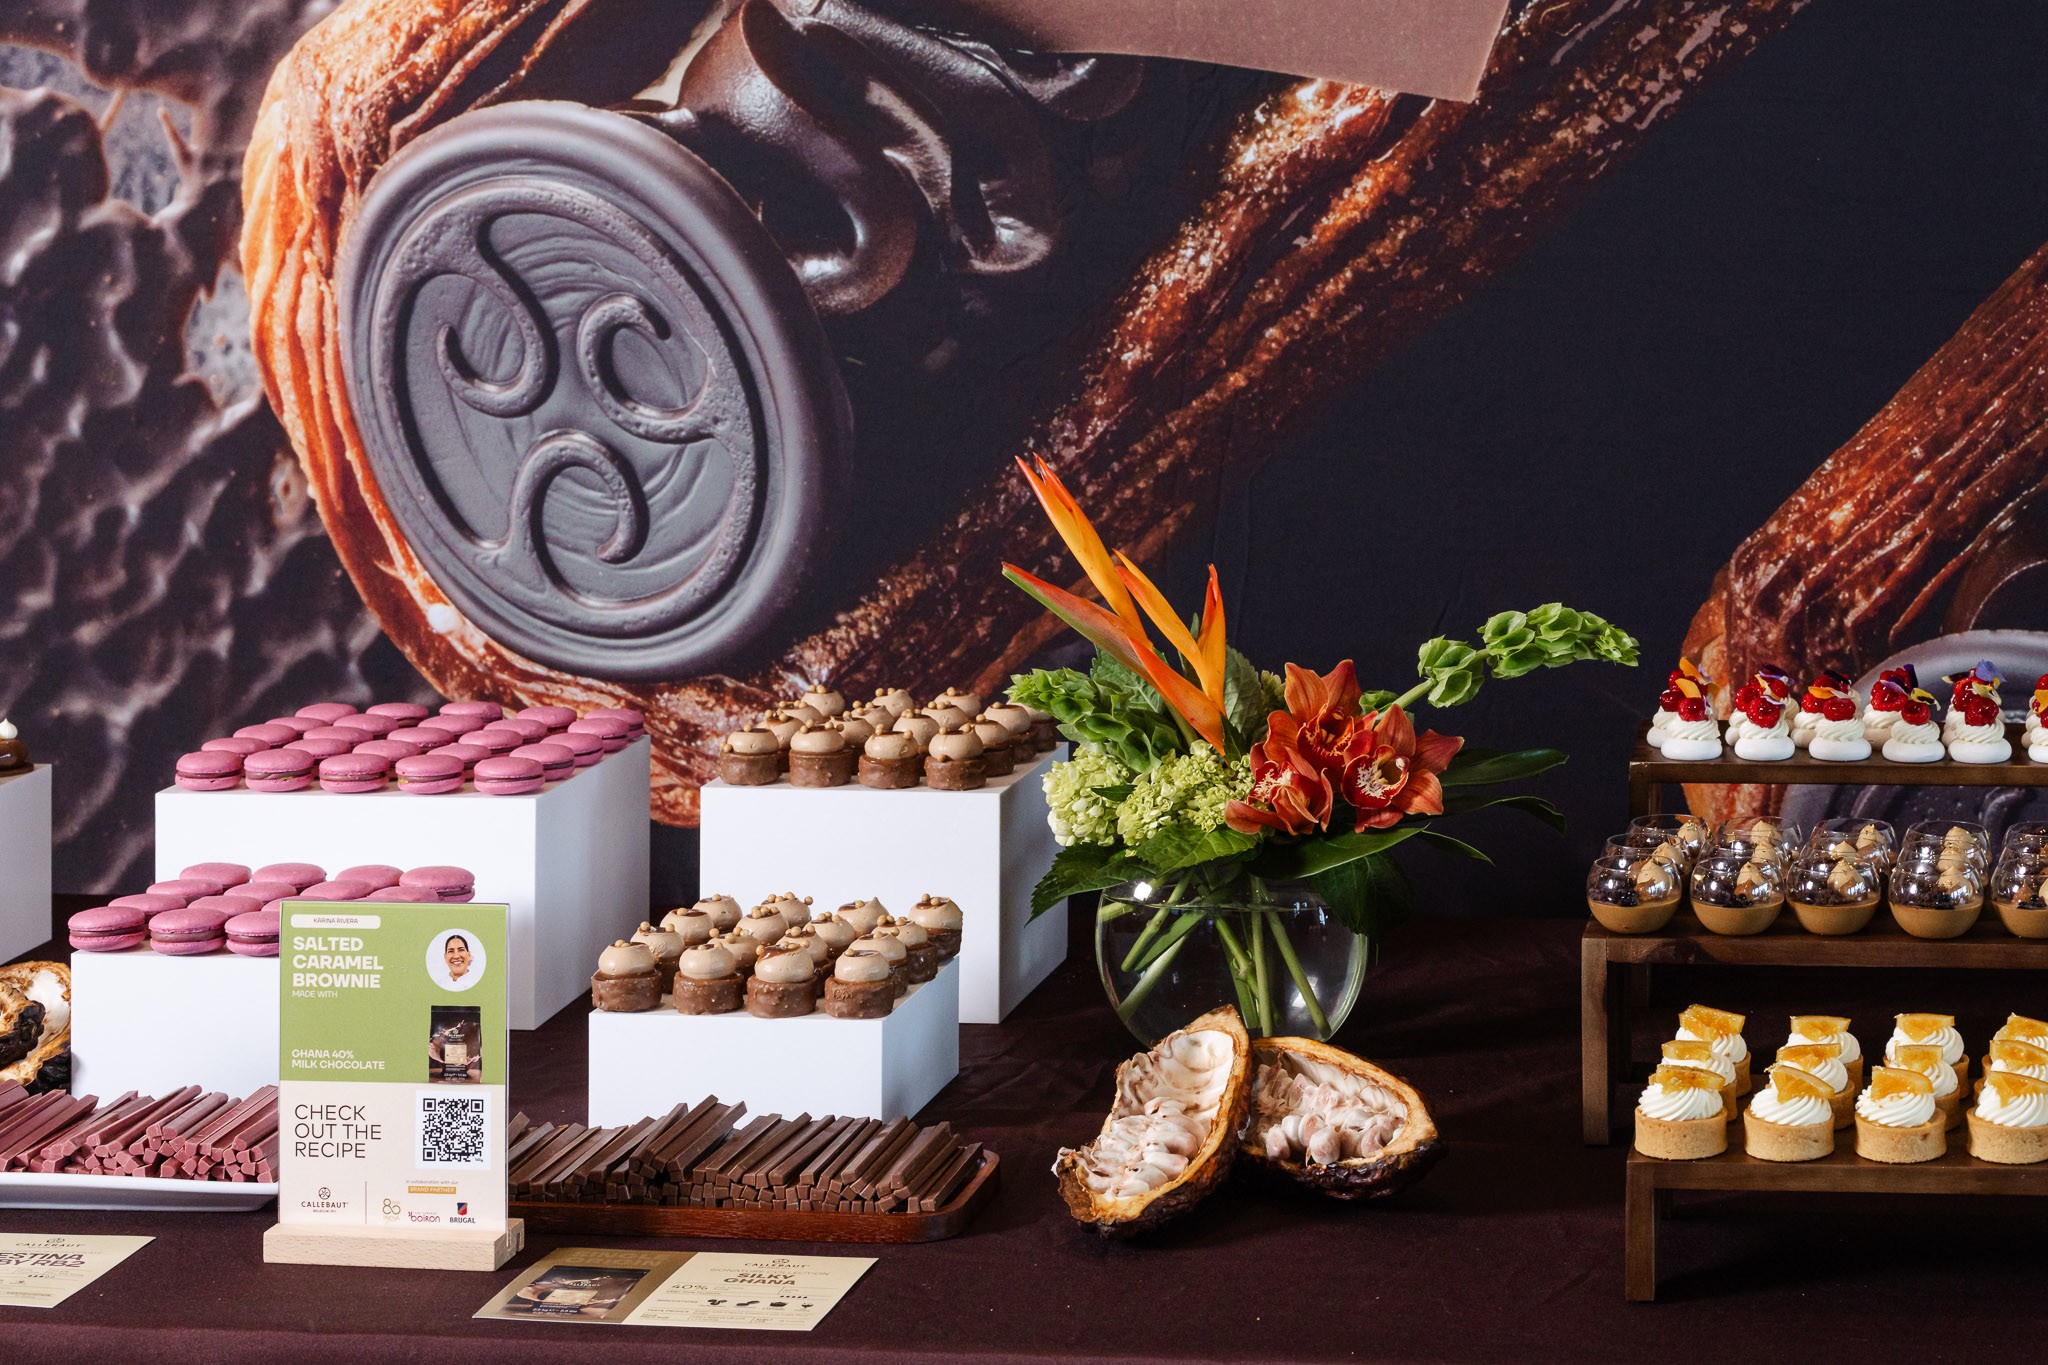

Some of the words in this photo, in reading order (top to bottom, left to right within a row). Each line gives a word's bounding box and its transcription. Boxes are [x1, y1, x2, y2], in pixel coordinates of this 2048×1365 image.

[293, 936, 364, 952] SALTED
[292, 954, 384, 970] CARAMEL
[292, 972, 381, 988] BROWNIE
[291, 1049, 330, 1058] GHANA
[332, 1050, 354, 1059] 40%
[291, 1060, 317, 1069] MILK
[319, 1060, 385, 1070] CHOCOLATE
[295, 1104, 366, 1121] CHECK
[295, 1123, 337, 1139] OUT
[342, 1124, 382, 1140] THE
[295, 1142, 366, 1159] RECIPE
[301, 1201, 347, 1209] CALLEBAUT
[31, 1260, 86, 1268] RB2
[723, 1277, 796, 1285] GHANA
[736, 1272, 796, 1280] SILKY
